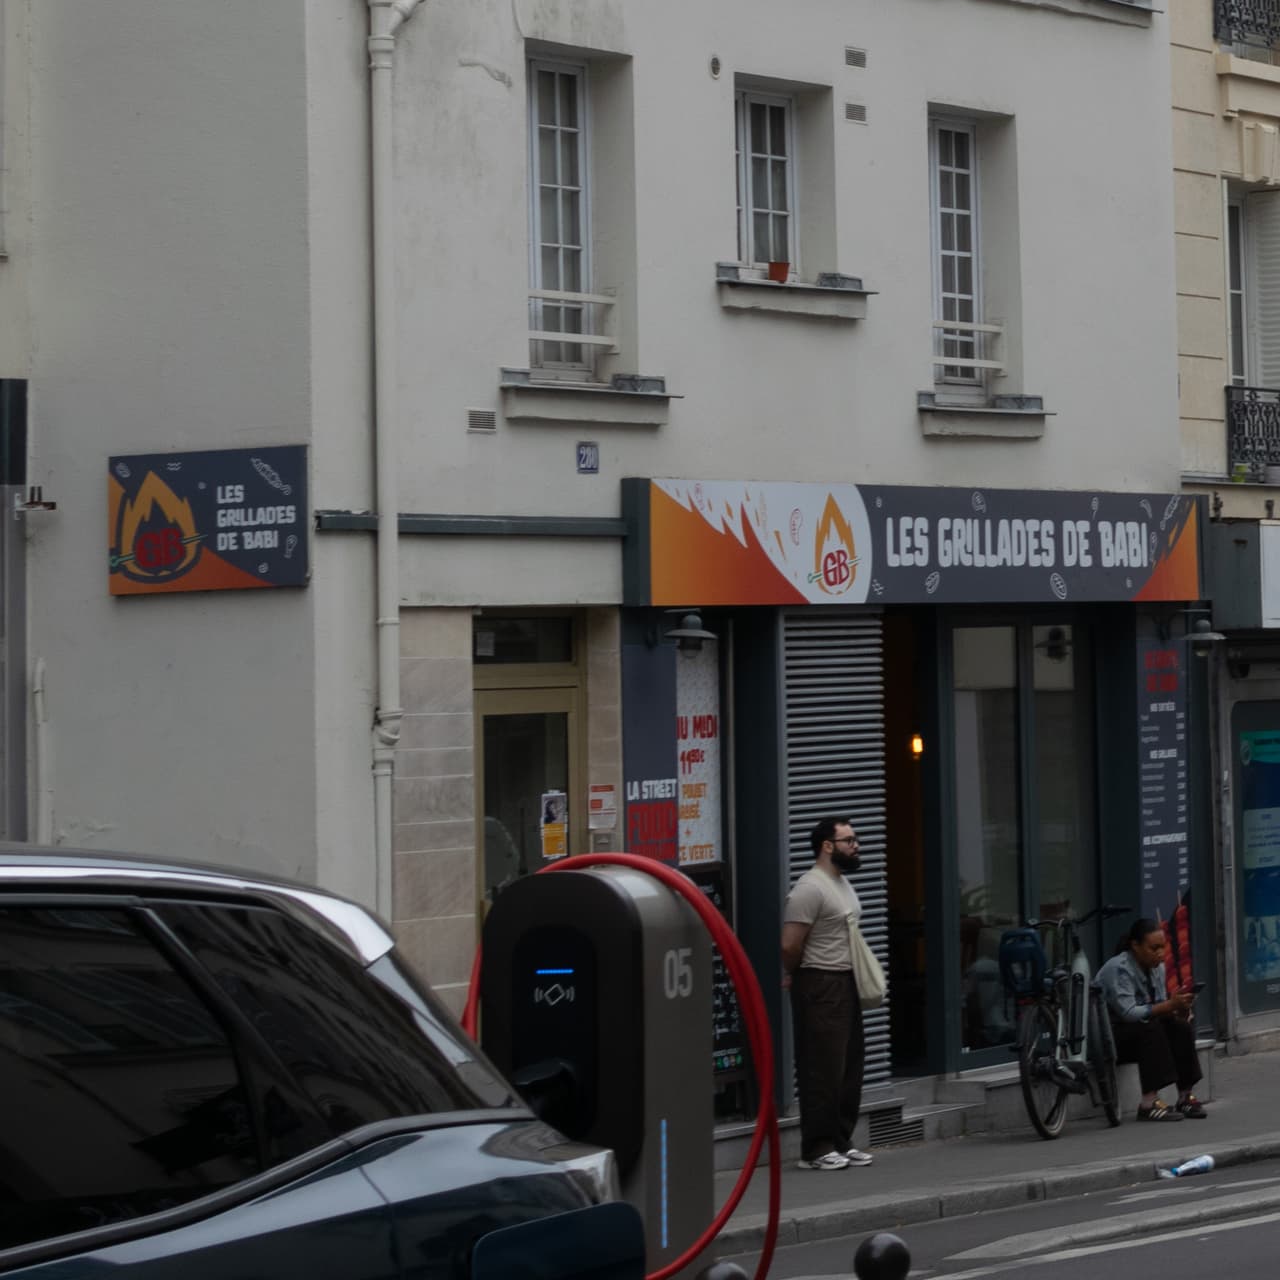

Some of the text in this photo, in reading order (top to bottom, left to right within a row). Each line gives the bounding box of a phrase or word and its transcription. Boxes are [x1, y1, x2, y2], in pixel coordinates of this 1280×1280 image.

[217, 484, 244, 505] LES
[217, 505, 296, 528] GRILLADES
[135, 527, 186, 568] GB
[217, 530, 278, 551] DE BABI
[887, 517, 1149, 569] LES GRILLADES DE BABI
[823, 550, 850, 587] GB
[627, 779, 677, 801] LA STREET
[628, 802, 677, 840] FOOD
[663, 948, 693, 1000] 05
